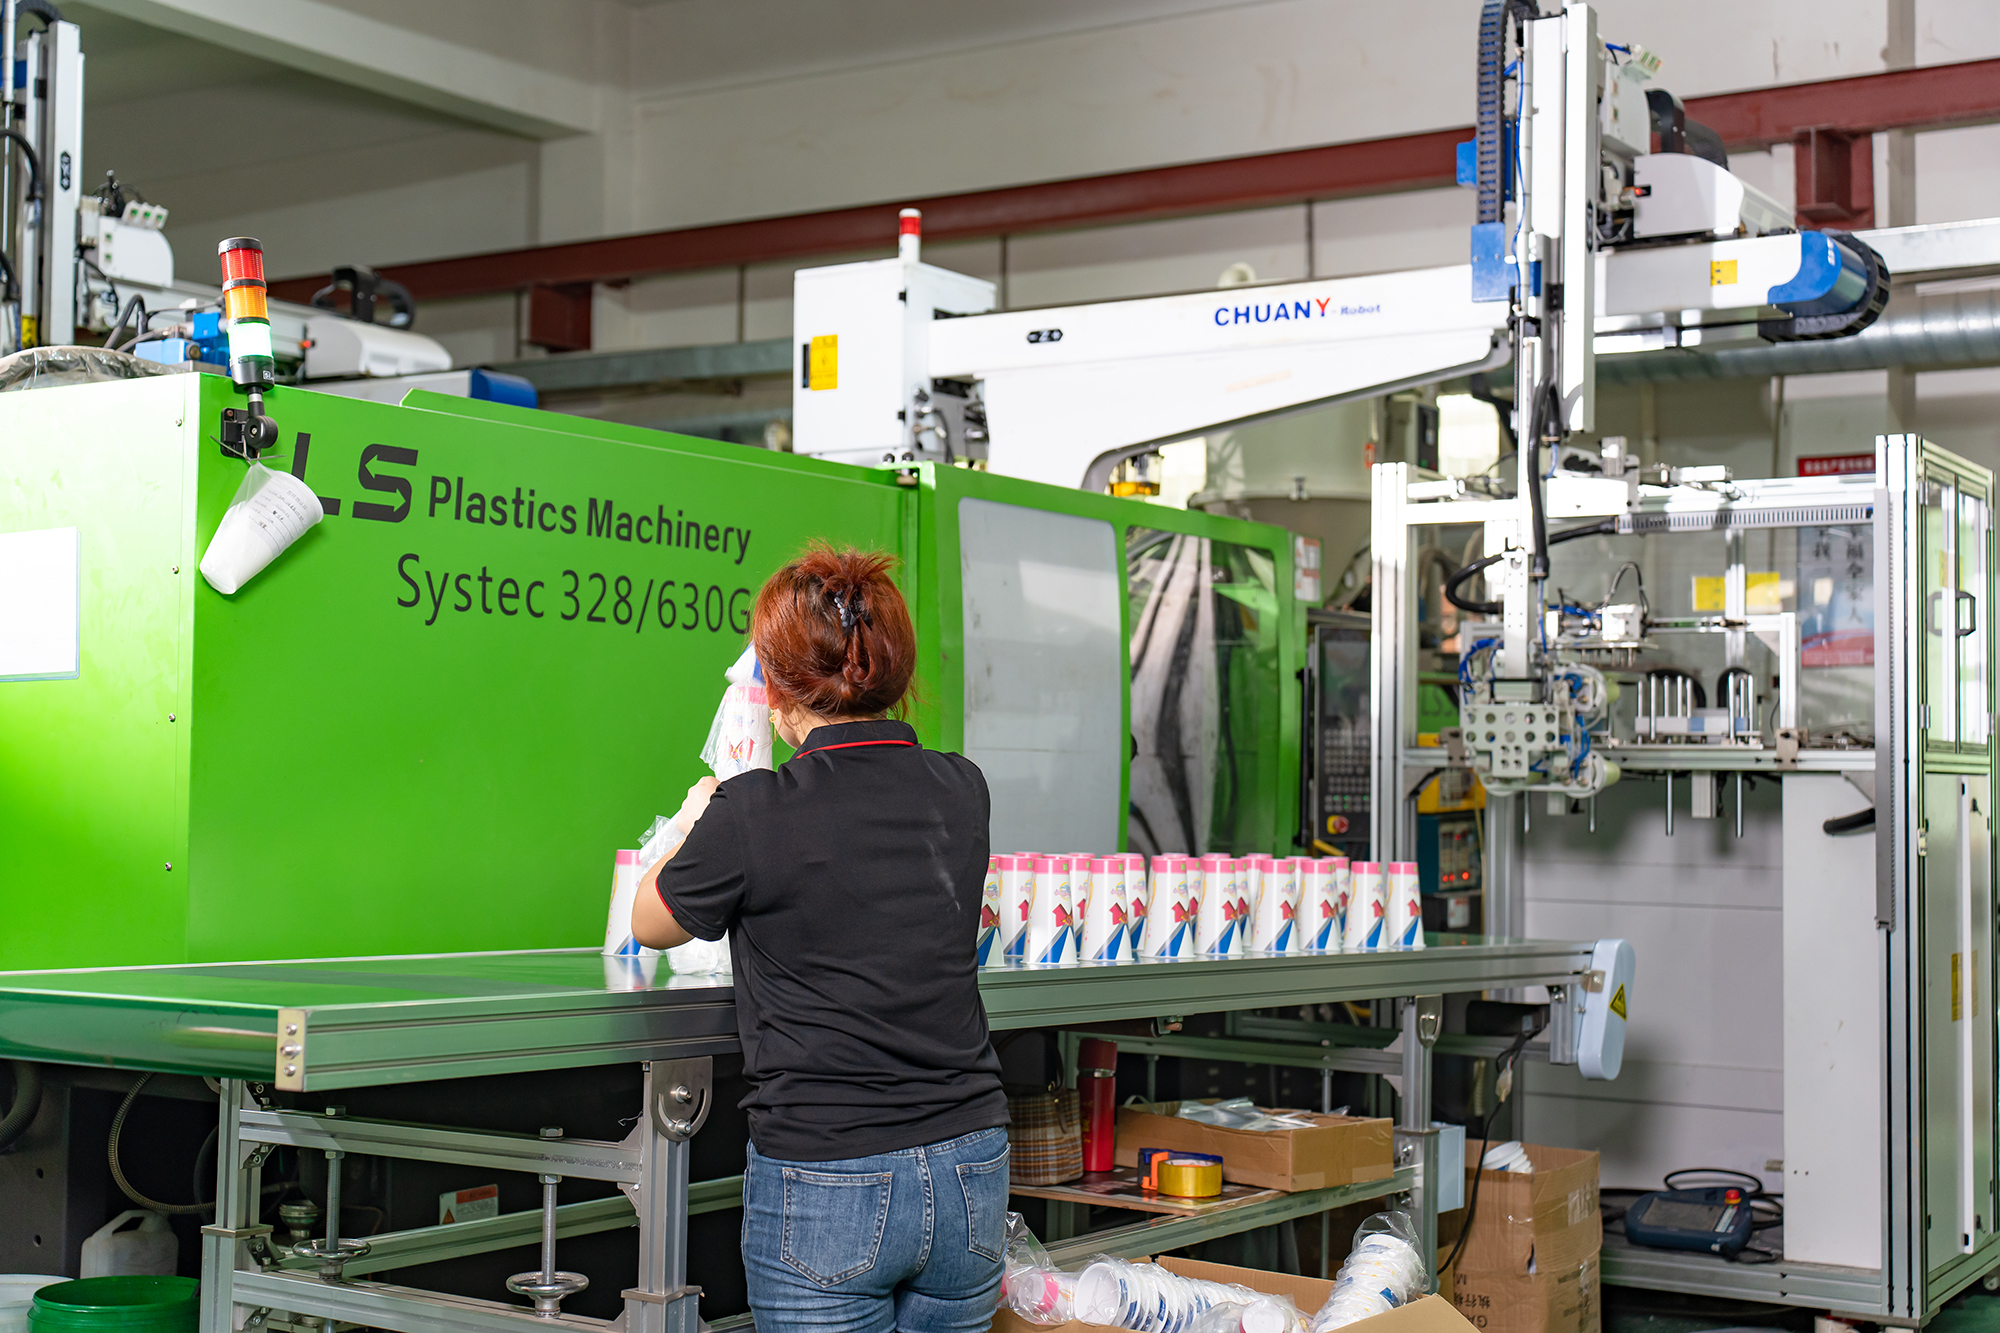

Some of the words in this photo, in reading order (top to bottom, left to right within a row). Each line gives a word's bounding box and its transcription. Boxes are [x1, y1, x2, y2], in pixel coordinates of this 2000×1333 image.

[1214, 297, 1331, 326] CHUANY
[428, 475, 577, 535] Plastics
[586, 497, 751, 565] Machinery
[397, 552, 545, 626] Systec
[560, 569, 751, 635] 328/630G
